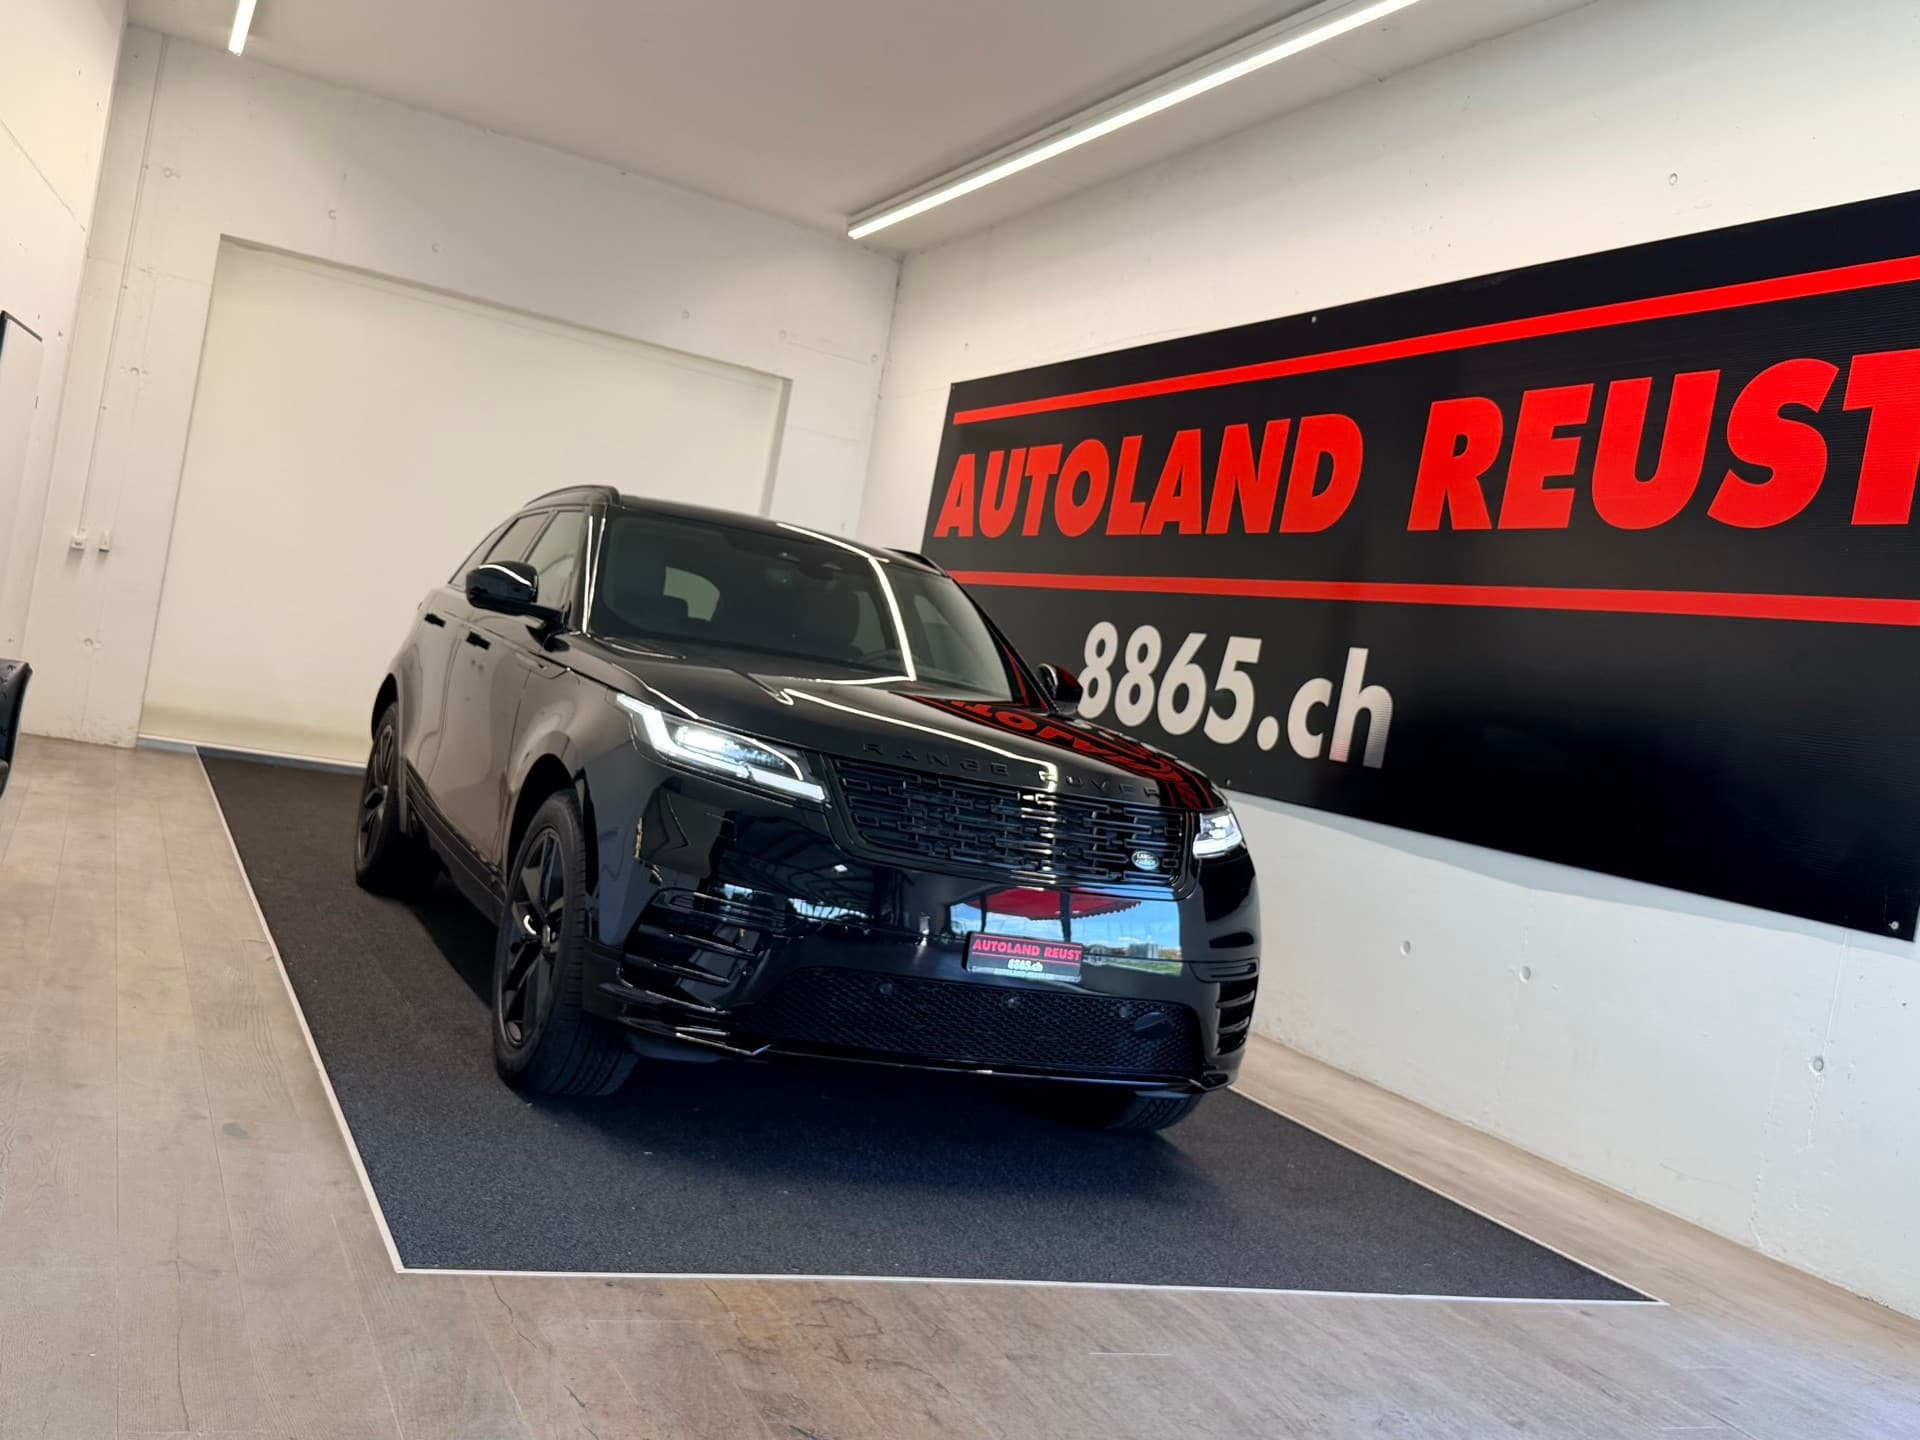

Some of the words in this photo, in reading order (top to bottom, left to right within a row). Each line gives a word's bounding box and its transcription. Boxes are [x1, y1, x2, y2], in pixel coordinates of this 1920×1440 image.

[935, 413, 1364, 538] AUTOLAND
[1407, 348, 1920, 531] REUST
[1077, 621, 1393, 769] 8865.ch
[863, 743, 1009, 777] RANGE
[973, 940, 1040, 957] AUTOLAND
[1044, 947, 1082, 961] REUST
